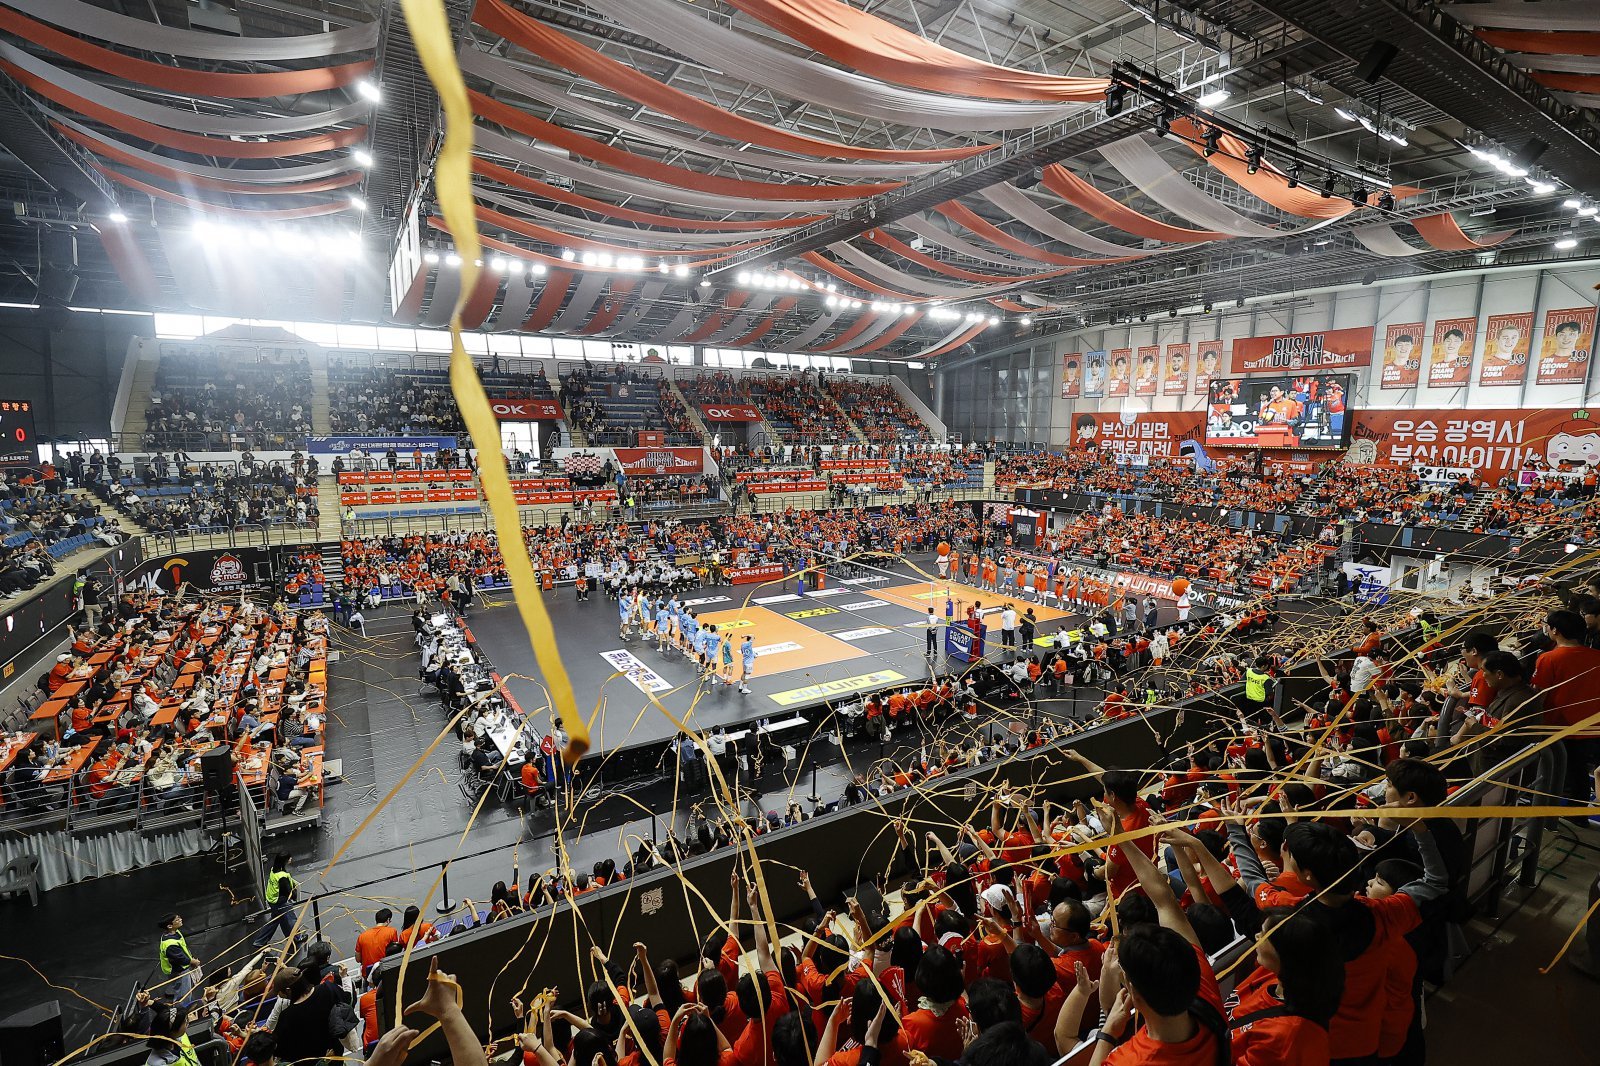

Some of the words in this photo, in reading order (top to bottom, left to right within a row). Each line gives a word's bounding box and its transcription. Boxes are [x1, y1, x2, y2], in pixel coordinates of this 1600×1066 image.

[1272, 334, 1324, 368] BUSAN
[1568, 349, 1587, 362] 19
[492, 404, 527, 415] OK
[708, 408, 735, 418] OK
[15, 428, 26, 442] 0
[1101, 421, 1140, 439] 부산이
[1141, 422, 1171, 440] 밀면,
[1393, 420, 1439, 442] 우승
[1444, 420, 1525, 444] 광역시
[1101, 440, 1138, 455] 읏맨은
[1140, 440, 1172, 457] 때려!
[1389, 445, 1438, 466] 부산
[1443, 446, 1534, 470] 아이가!
[1130, 579, 1175, 597] JINAI
[1187, 590, 1207, 603] OK
